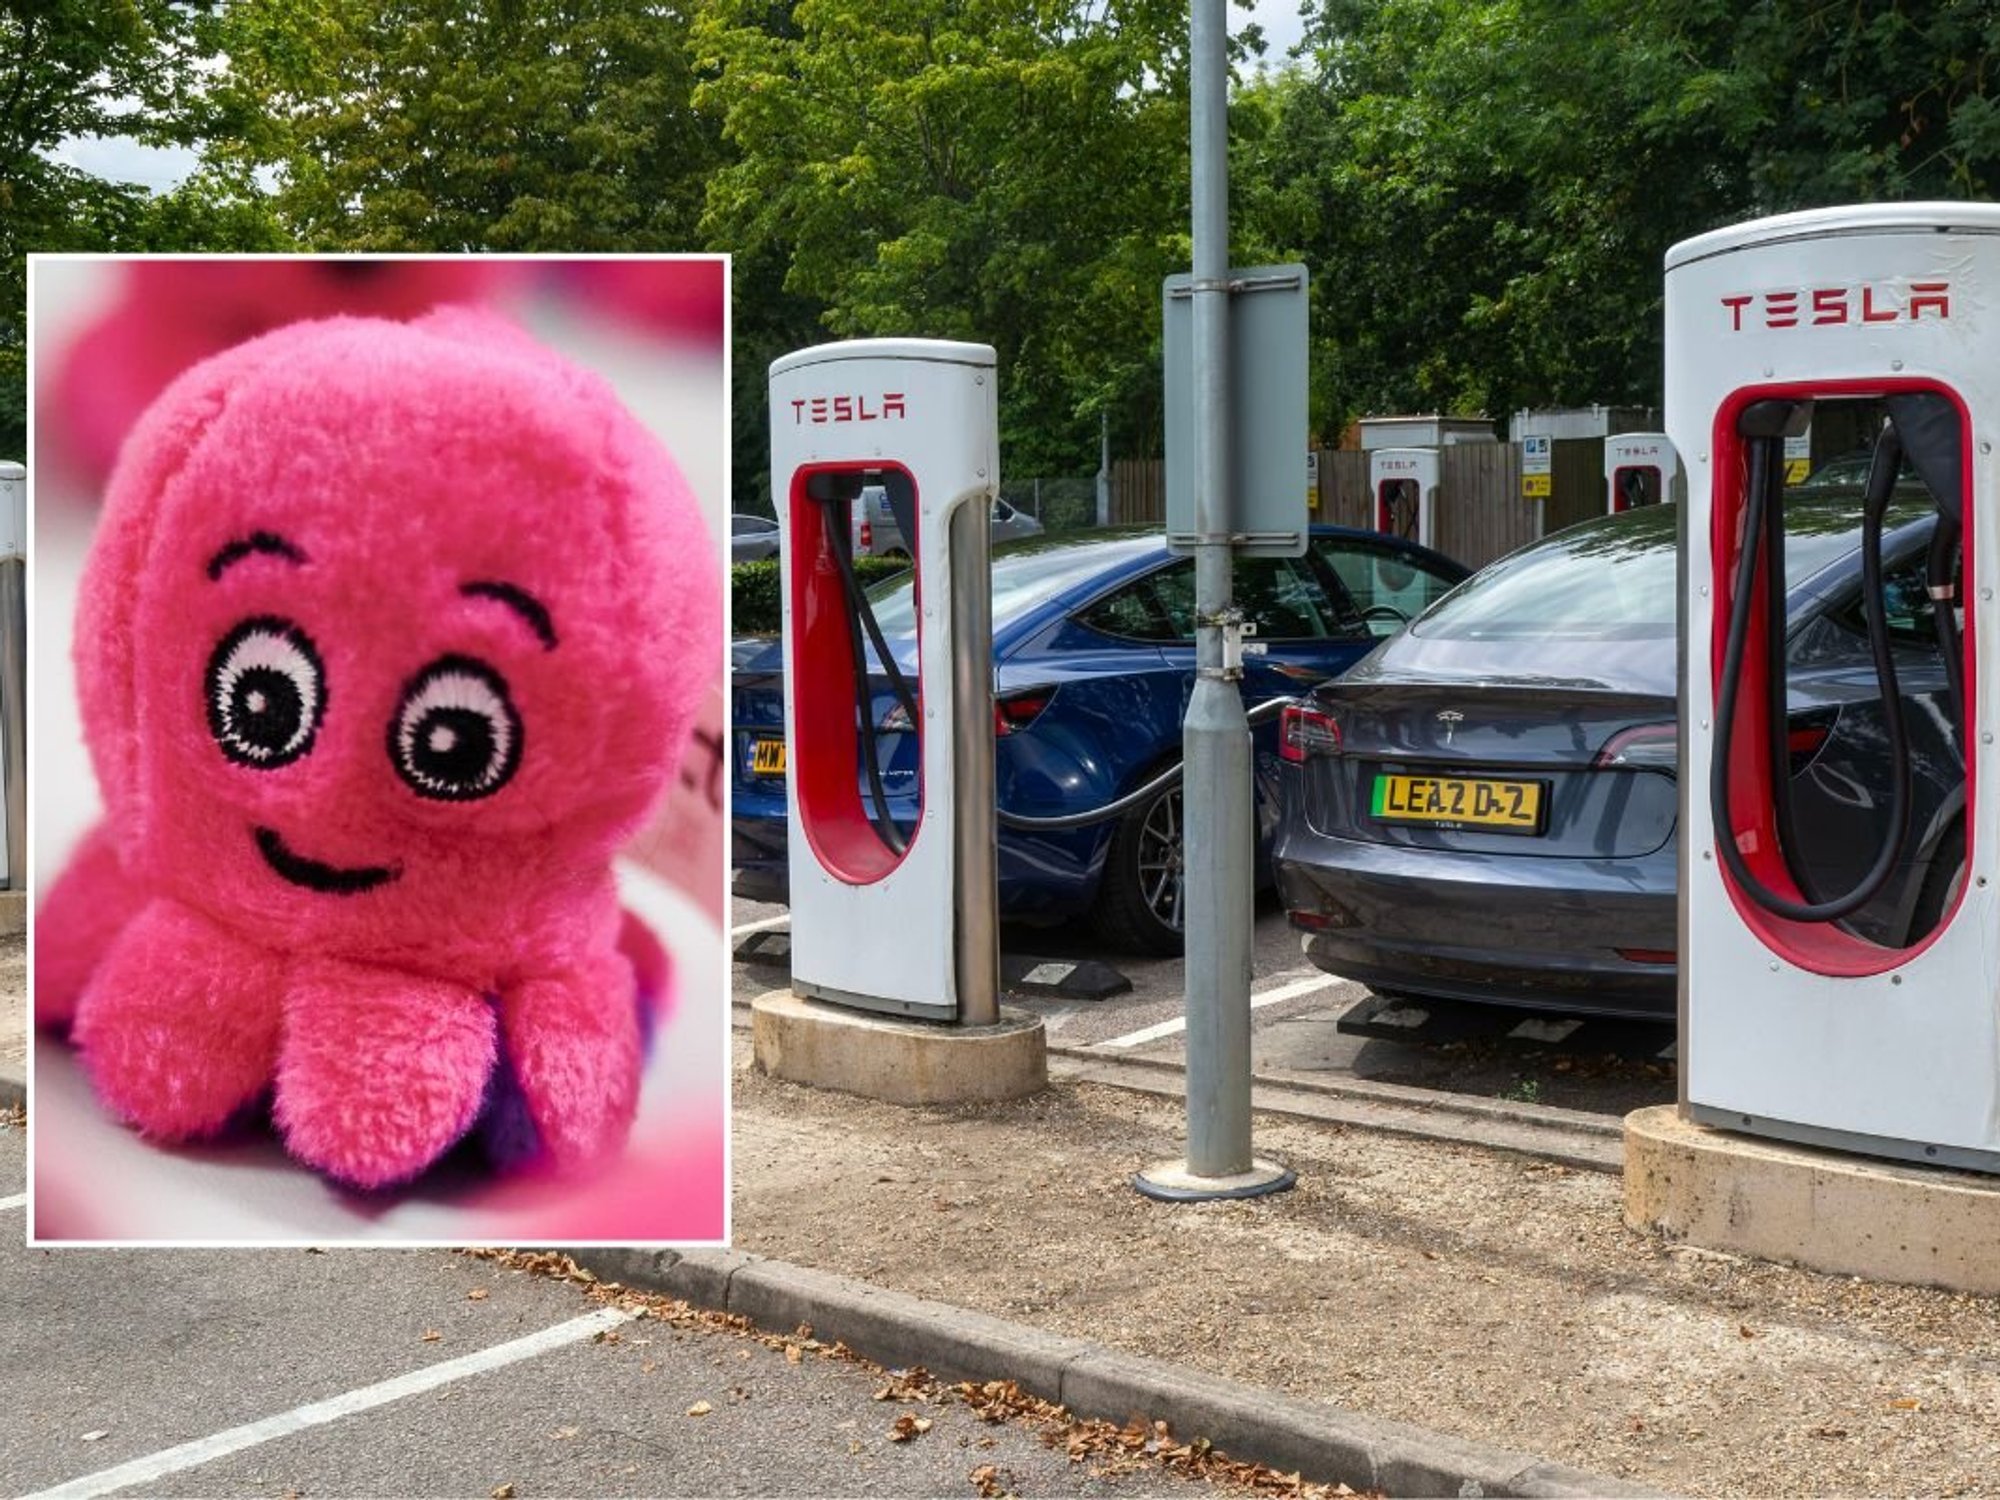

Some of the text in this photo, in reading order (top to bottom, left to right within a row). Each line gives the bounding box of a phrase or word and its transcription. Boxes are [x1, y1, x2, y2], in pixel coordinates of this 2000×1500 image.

[1720, 283, 1949, 331] TESLA
[791, 393, 905, 425] TESLA
[1615, 446, 1659, 456] TESLA
[1380, 460, 1418, 470] TESLA
